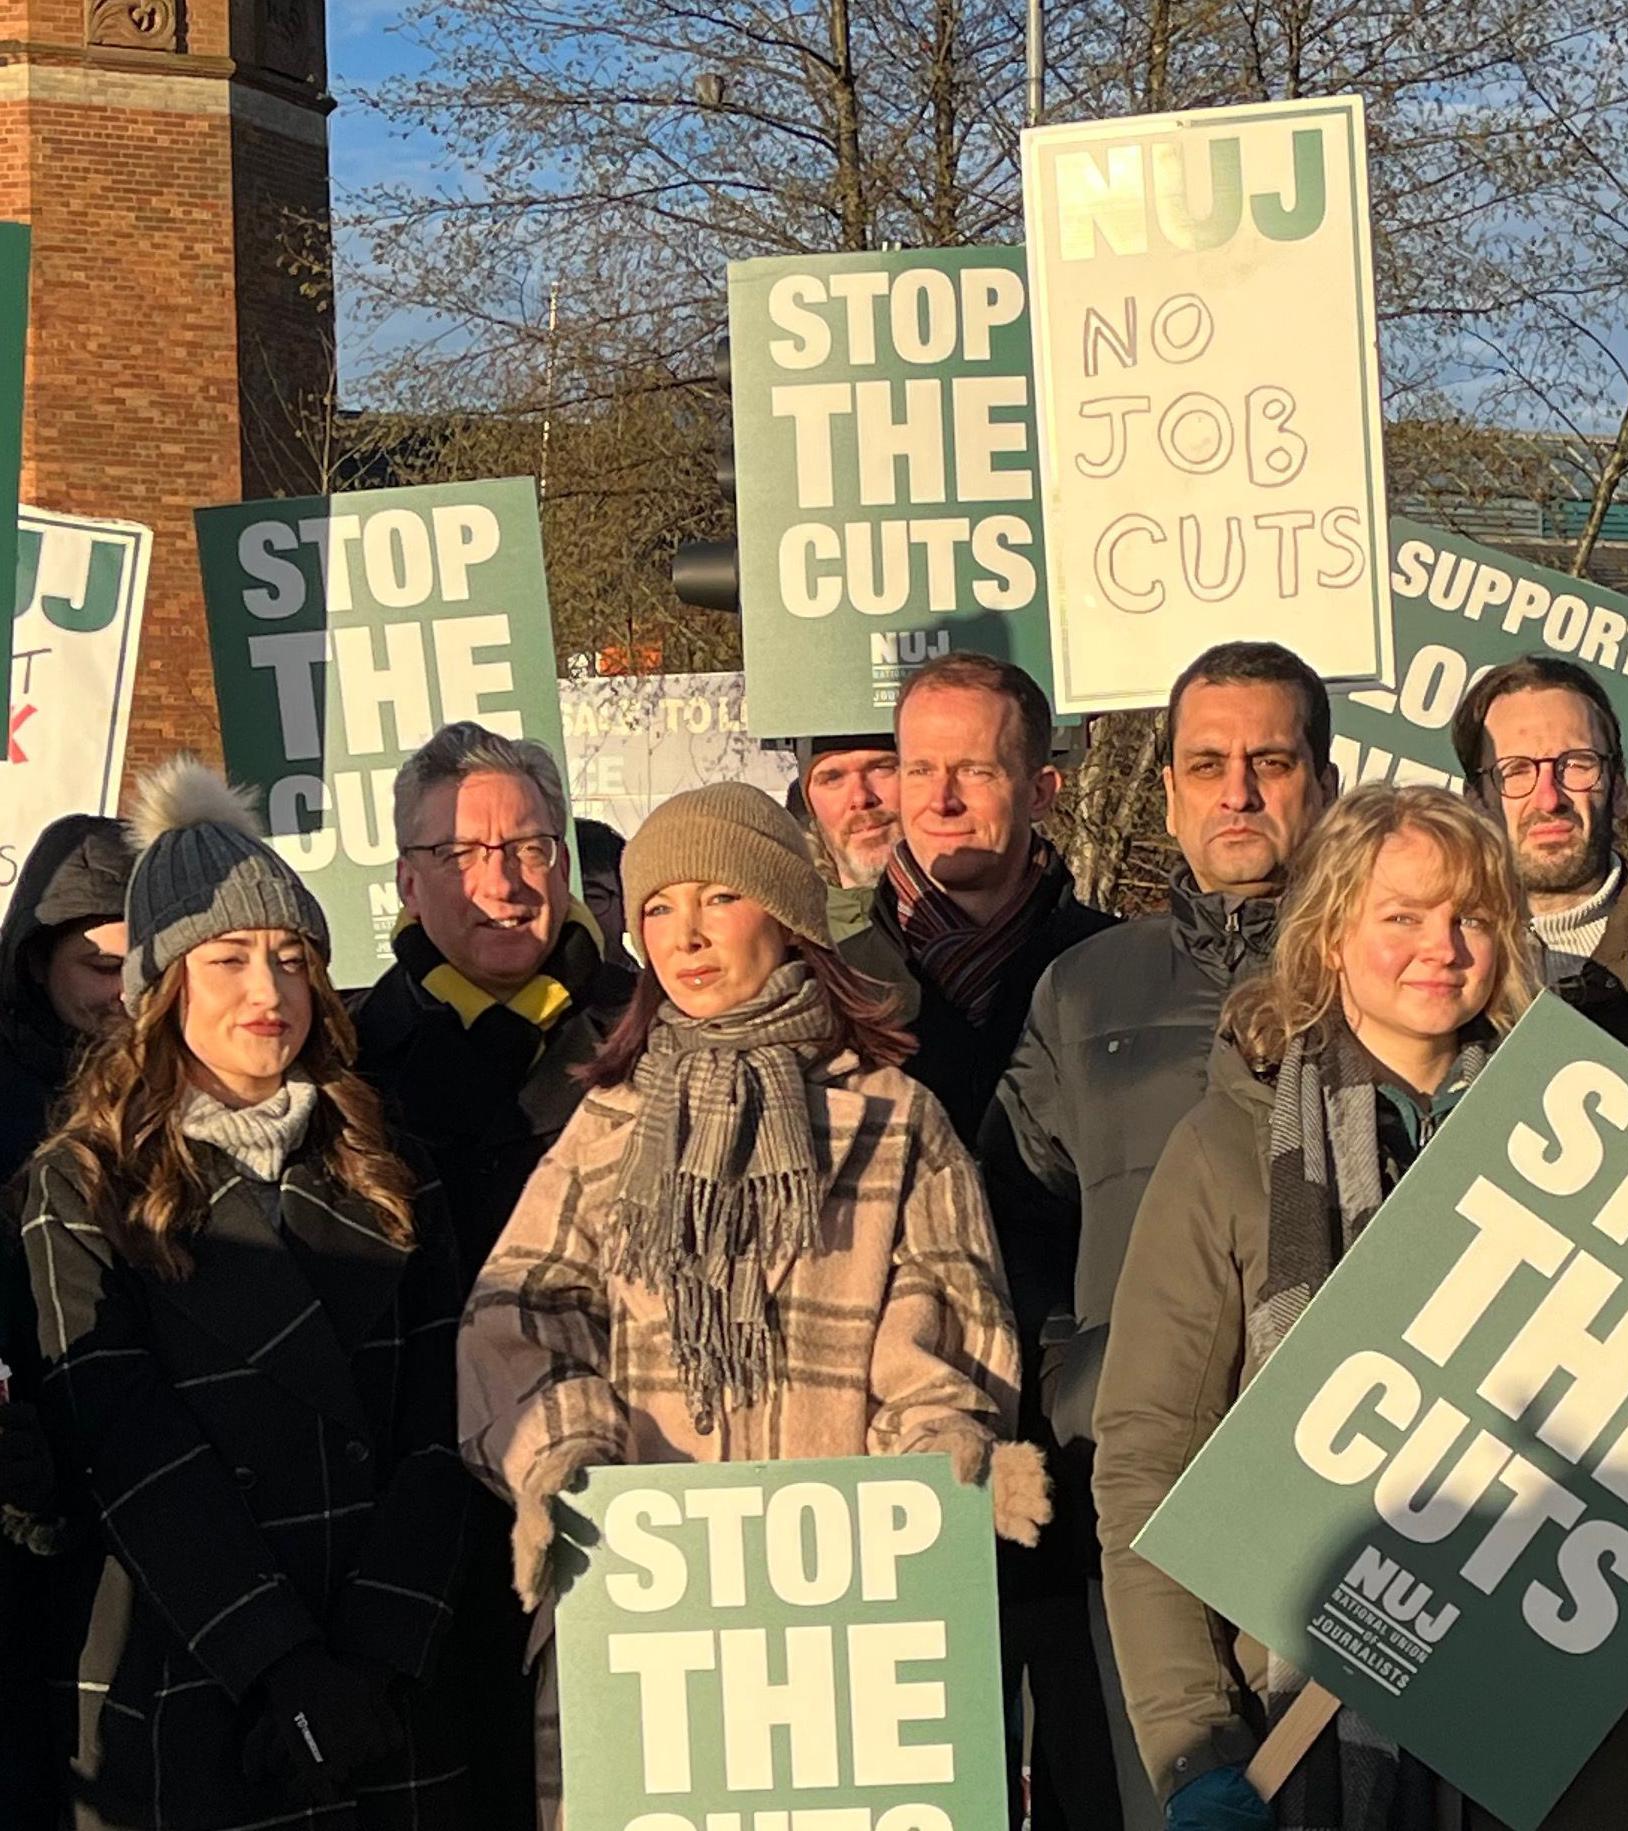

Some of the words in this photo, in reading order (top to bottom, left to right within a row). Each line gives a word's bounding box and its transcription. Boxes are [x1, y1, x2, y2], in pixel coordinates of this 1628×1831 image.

[1055, 128, 1327, 262] NUJ
[768, 266, 1026, 370] STOP
[1083, 292, 1214, 377] NO
[772, 375, 1034, 508] THE
[1074, 385, 1308, 487] JOB
[238, 504, 500, 620] STOP
[779, 514, 1037, 618] CUTS
[1094, 505, 1367, 615] CUTS
[249, 613, 521, 762] THE
[870, 630, 950, 664] NUJ
[269, 768, 399, 872] CU
[604, 1480, 942, 1612] STOP
[1344, 1544, 1460, 1643] NUJ
[1312, 1614, 1410, 1689] JOURNALISTS
[1331, 1589, 1387, 1634] NATIONAL
[1389, 1629, 1429, 1664] UNION
[1363, 1630, 1379, 1645] OF
[608, 1620, 954, 1794] THE
